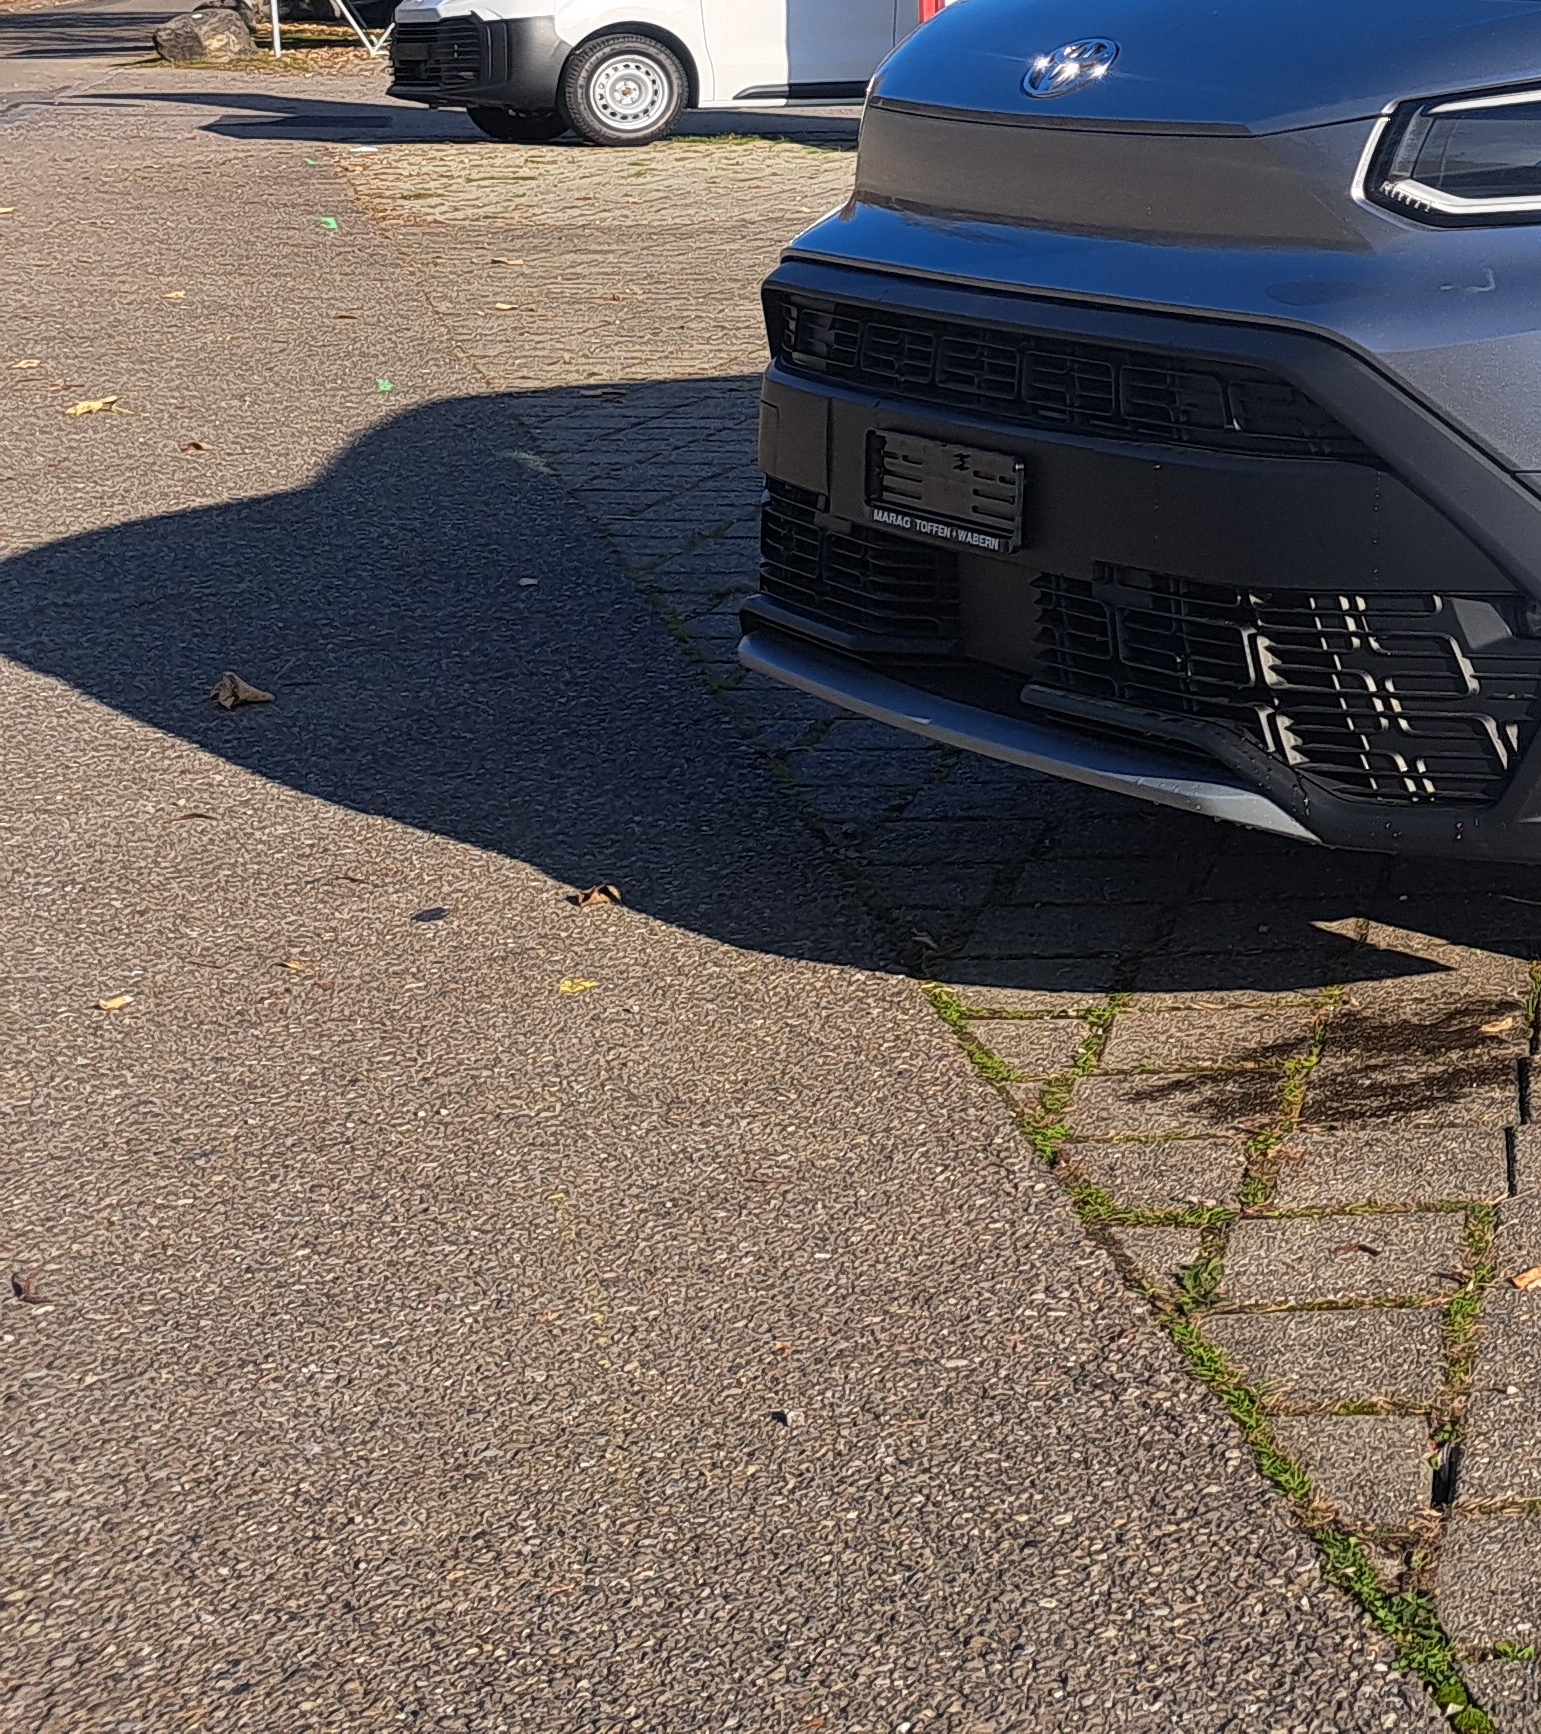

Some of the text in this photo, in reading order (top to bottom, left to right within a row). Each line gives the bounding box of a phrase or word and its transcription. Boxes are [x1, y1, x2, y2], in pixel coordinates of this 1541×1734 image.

[873, 509, 999, 551] MARAG TOFFEN WABERN
